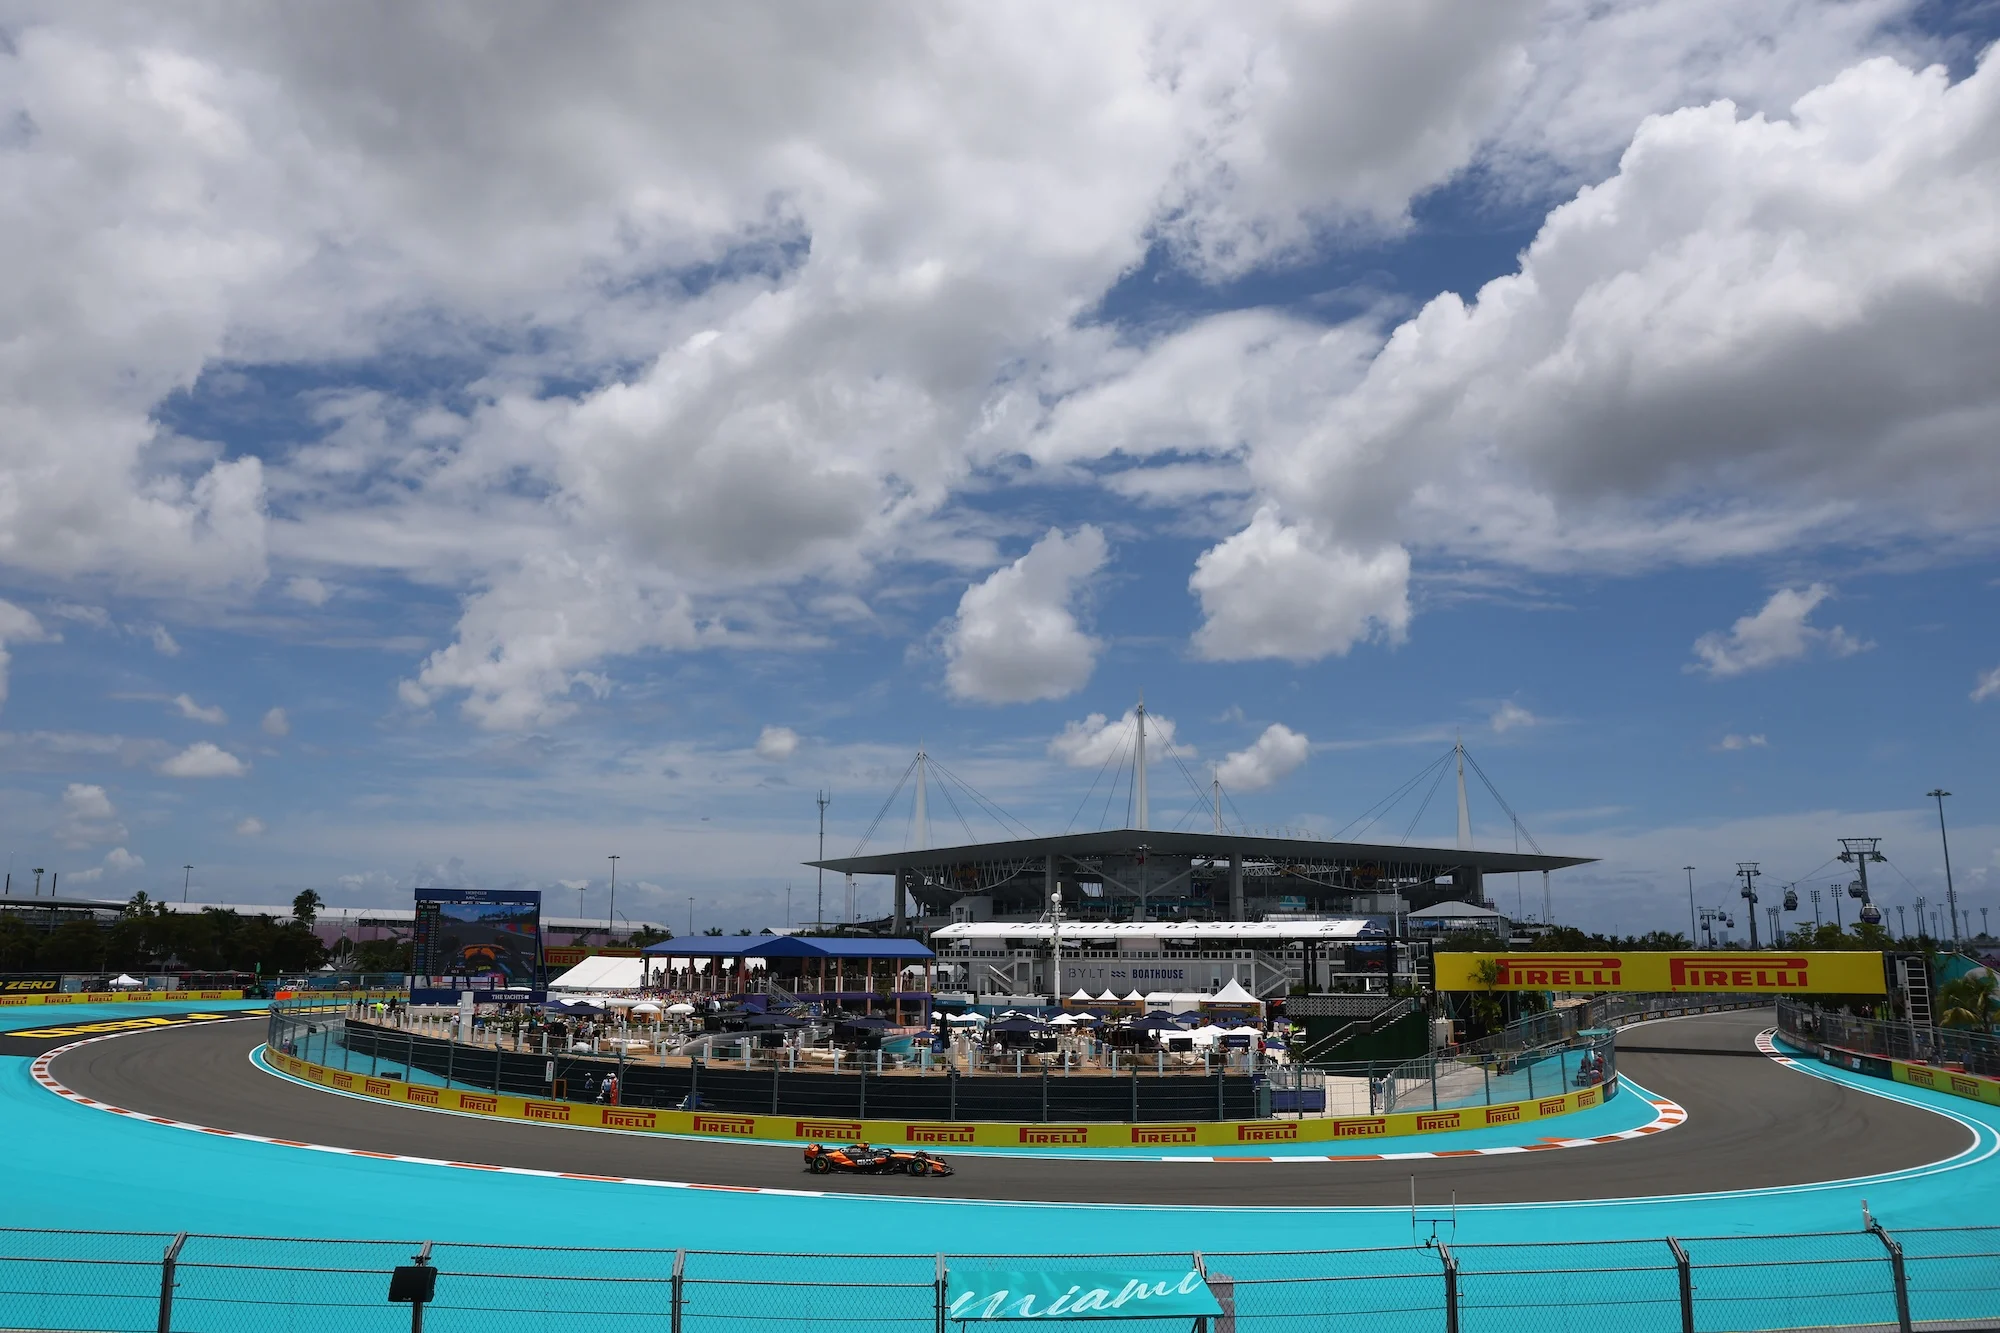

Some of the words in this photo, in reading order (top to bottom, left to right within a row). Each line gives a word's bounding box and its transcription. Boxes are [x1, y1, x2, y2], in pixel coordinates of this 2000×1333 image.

[1068, 968, 1104, 978] BYLT
[1132, 969, 1184, 979] BOATHOUSE
[1496, 958, 1622, 985] PIRELLI
[1670, 958, 1808, 986] PIRELLI
[5, 981, 56, 990] ZERO
[44, 995, 72, 1004] PIRELLI
[1628, 1014, 1640, 1022] KEEPER
[308, 1066, 323, 1081] PIRELLI
[333, 1073, 352, 1088] PIRELLI
[1908, 1067, 1935, 1087] PIRELLI
[365, 1080, 390, 1096] PIRELLI
[1951, 1076, 1980, 1097] PIRELLI
[408, 1087, 439, 1104] PIRELLI
[460, 1095, 497, 1113] PIRELLI
[1578, 1091, 1595, 1107] PIRELLI
[524, 1102, 570, 1121] PIRELLI
[1486, 1106, 1520, 1124] PIRELLI
[1540, 1099, 1565, 1116] PIRELLI
[602, 1110, 656, 1128] PIRELLI
[694, 1116, 754, 1134] PIRELLI
[1334, 1118, 1386, 1136] PIRELLI
[1417, 1113, 1460, 1130] PIRELLI
[796, 1122, 862, 1140] PIRELLI
[906, 1126, 975, 1142] PIRELLI
[1020, 1128, 1087, 1143] PIRELLI
[1132, 1127, 1196, 1143] PIRELLI
[1238, 1124, 1297, 1140] PIRELLI
